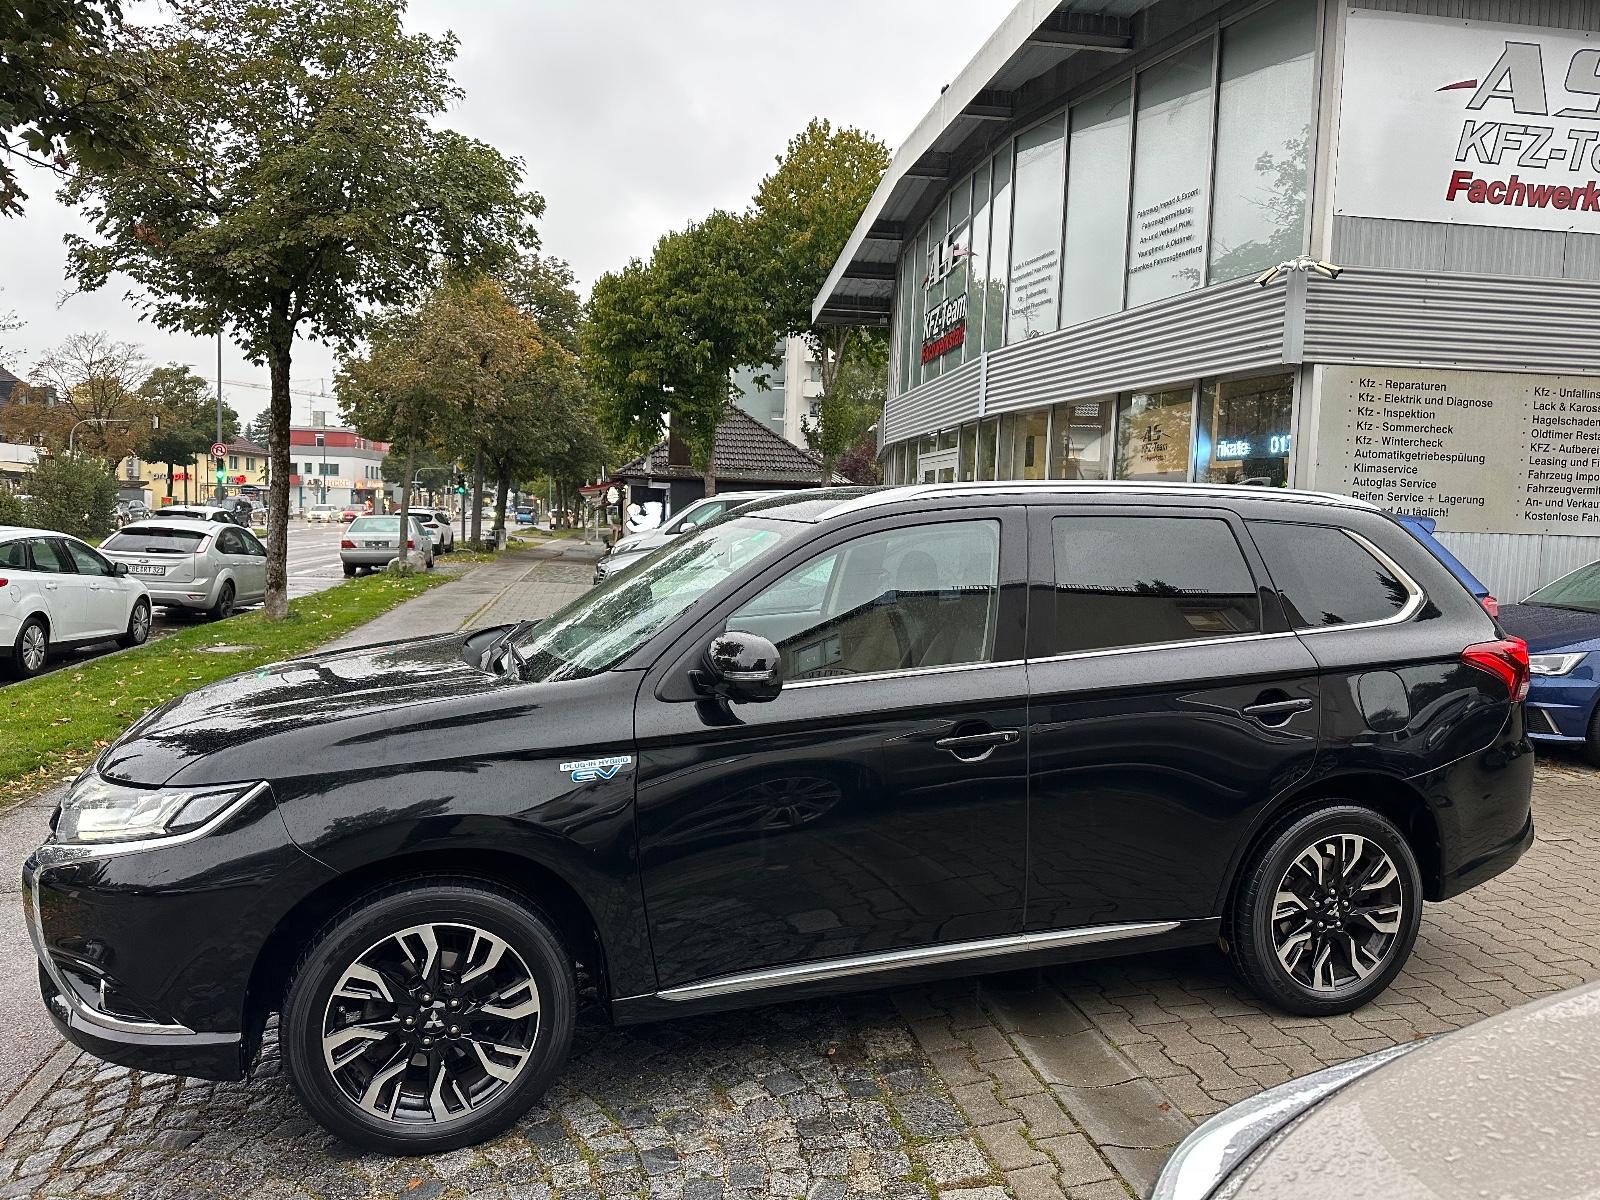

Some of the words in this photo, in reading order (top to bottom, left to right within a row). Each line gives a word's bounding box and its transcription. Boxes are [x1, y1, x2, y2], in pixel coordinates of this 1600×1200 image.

[1446, 170, 1600, 212] Fachwerk
[1359, 378, 1376, 388] Kfz
[1385, 379, 1447, 391] Reparaturen
[1534, 386, 1550, 397] Kfz
[1358, 392, 1375, 402] Kfz
[1384, 394, 1422, 404] Elektrik
[1424, 396, 1444, 406] und
[1446, 396, 1493, 409] Diagnose
[1533, 401, 1557, 411] Lack
[1559, 402, 1566, 412] &
[1357, 407, 1374, 417] Kfz
[1383, 407, 1436, 420] Inspektion
[1356, 421, 1373, 431] Kfz
[1382, 422, 1454, 434] Sommercheck
[1531, 428, 1574, 440] Oldtimer
[1355, 435, 1372, 445] Kfz
[1381, 436, 1443, 448] Wintercheck
[1530, 442, 1551, 453] KFZ
[1354, 449, 1486, 464] Automatikgetriebespülung
[1529, 456, 1567, 469] Leasing
[1570, 457, 1589, 467] und
[1353, 463, 1418, 474] Klimaservice
[1528, 469, 1573, 483] Fahrzeug
[1352, 477, 1397, 489] Autoglas
[1399, 478, 1437, 489] Service
[1351, 491, 1384, 501] Reifen
[1386, 492, 1424, 503] Service
[1438, 493, 1485, 506] Lagerung
[1525, 497, 1543, 507] An-
[1545, 499, 1564, 507] und
[1567, 498, 1600, 509] Verkau
[1524, 511, 1579, 521] Kostenlose
[563, 761, 597, 770] PLUG-IN
[598, 756, 629, 766] HYBRID
[571, 764, 622, 783] EV
